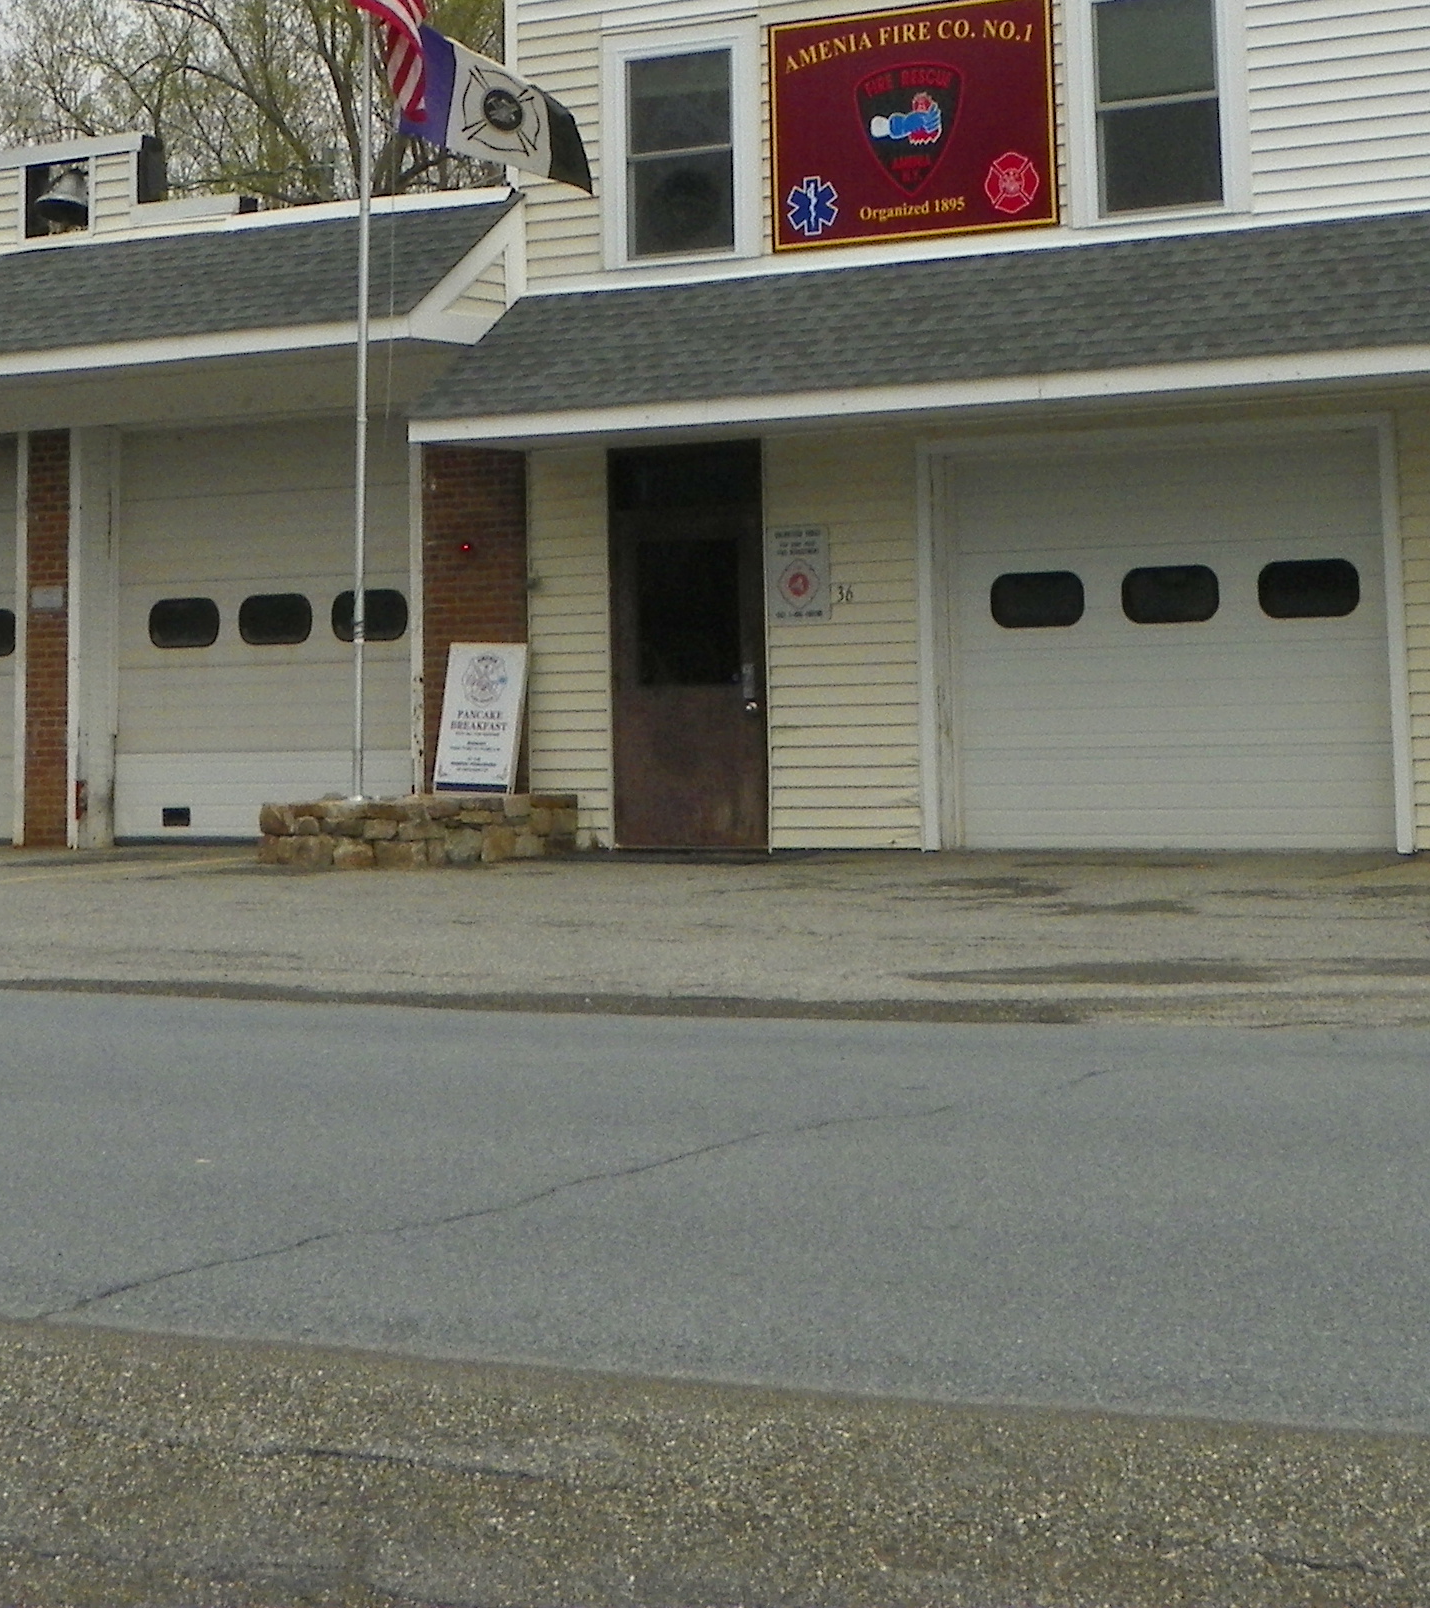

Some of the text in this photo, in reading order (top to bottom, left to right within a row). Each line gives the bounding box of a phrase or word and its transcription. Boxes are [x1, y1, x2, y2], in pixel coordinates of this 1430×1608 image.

[785, 32, 872, 74] AMENIA
[879, 21, 931, 47] FIRE
[937, 19, 976, 40] CO.
[901, 69, 951, 89] RESCUE
[859, 196, 966, 222] Organized 1895
[838, 585, 853, 602] 36
[458, 710, 502, 719] PANCAKE
[451, 721, 507, 731] BREAKFAST
